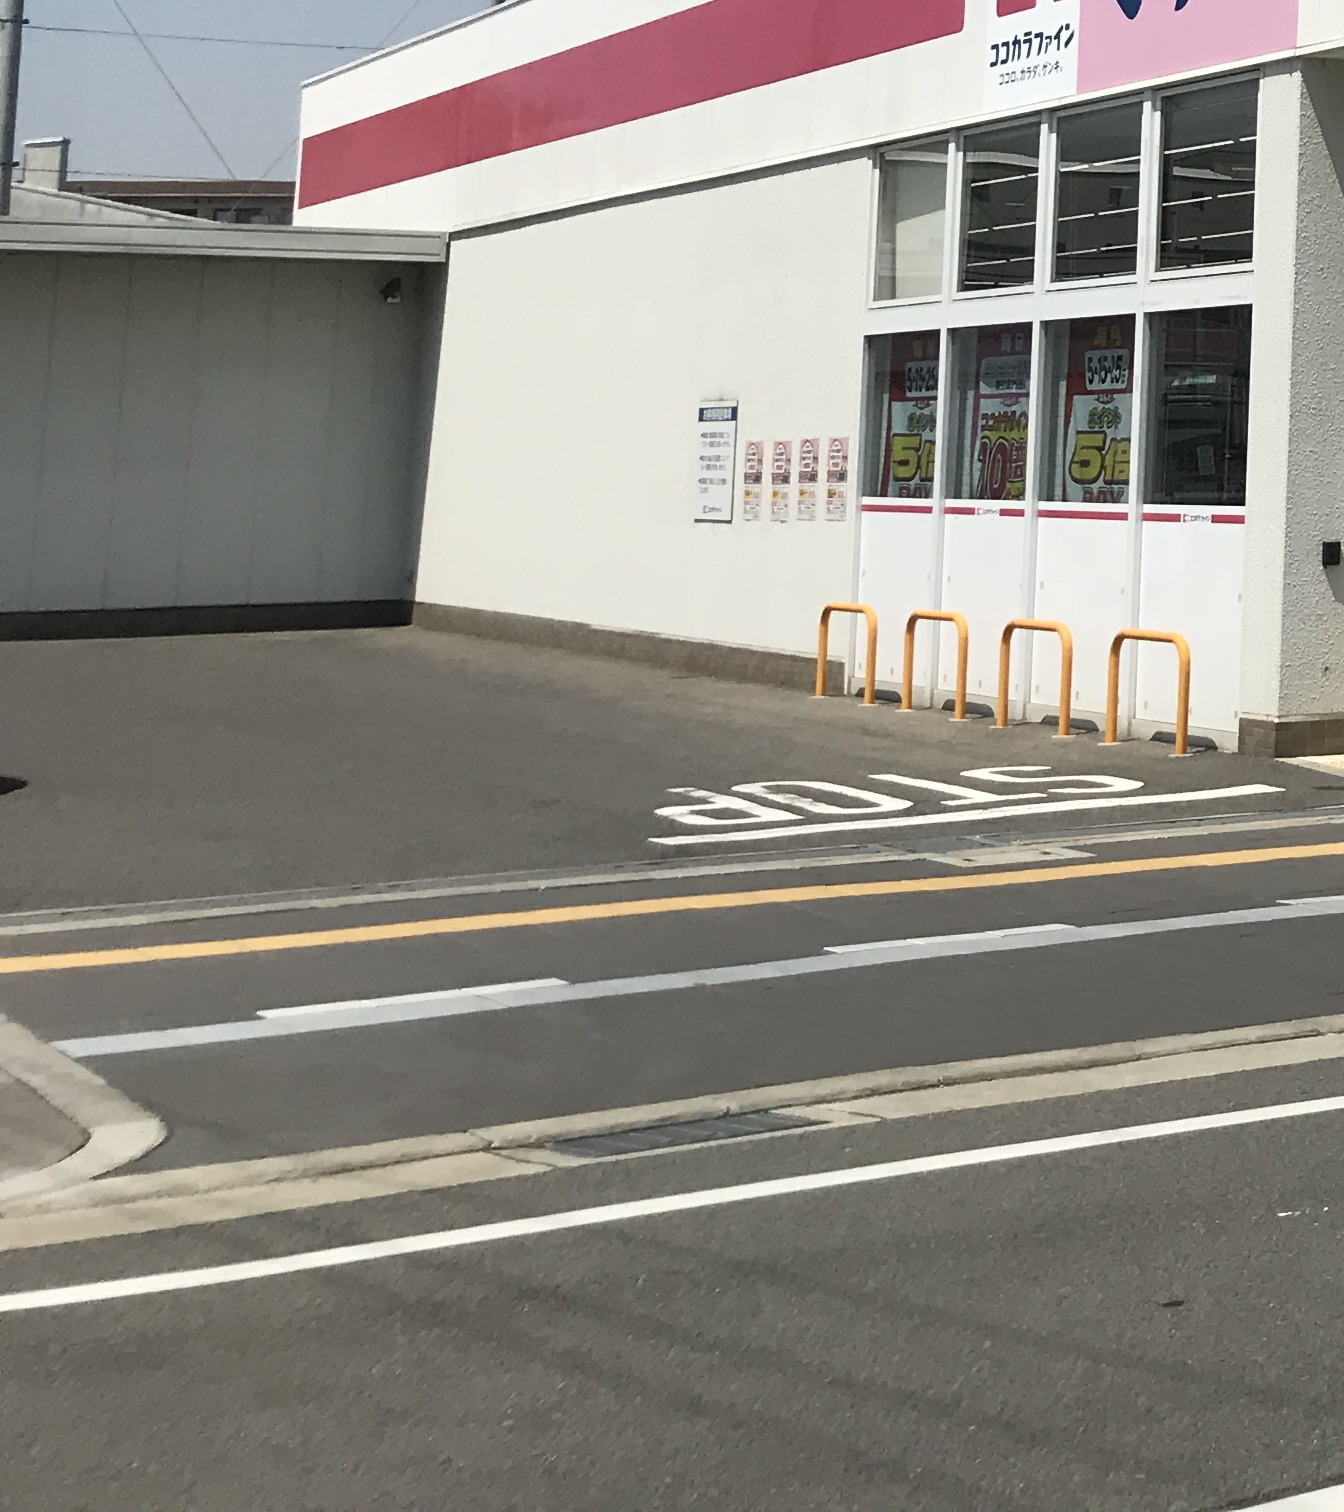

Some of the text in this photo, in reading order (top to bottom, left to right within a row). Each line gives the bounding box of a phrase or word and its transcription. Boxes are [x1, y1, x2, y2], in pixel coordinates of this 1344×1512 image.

[989, 23, 1075, 68] ココカラファイン
[1069, 430, 1131, 486] 5倍
[654, 765, 1145, 826] STOP
